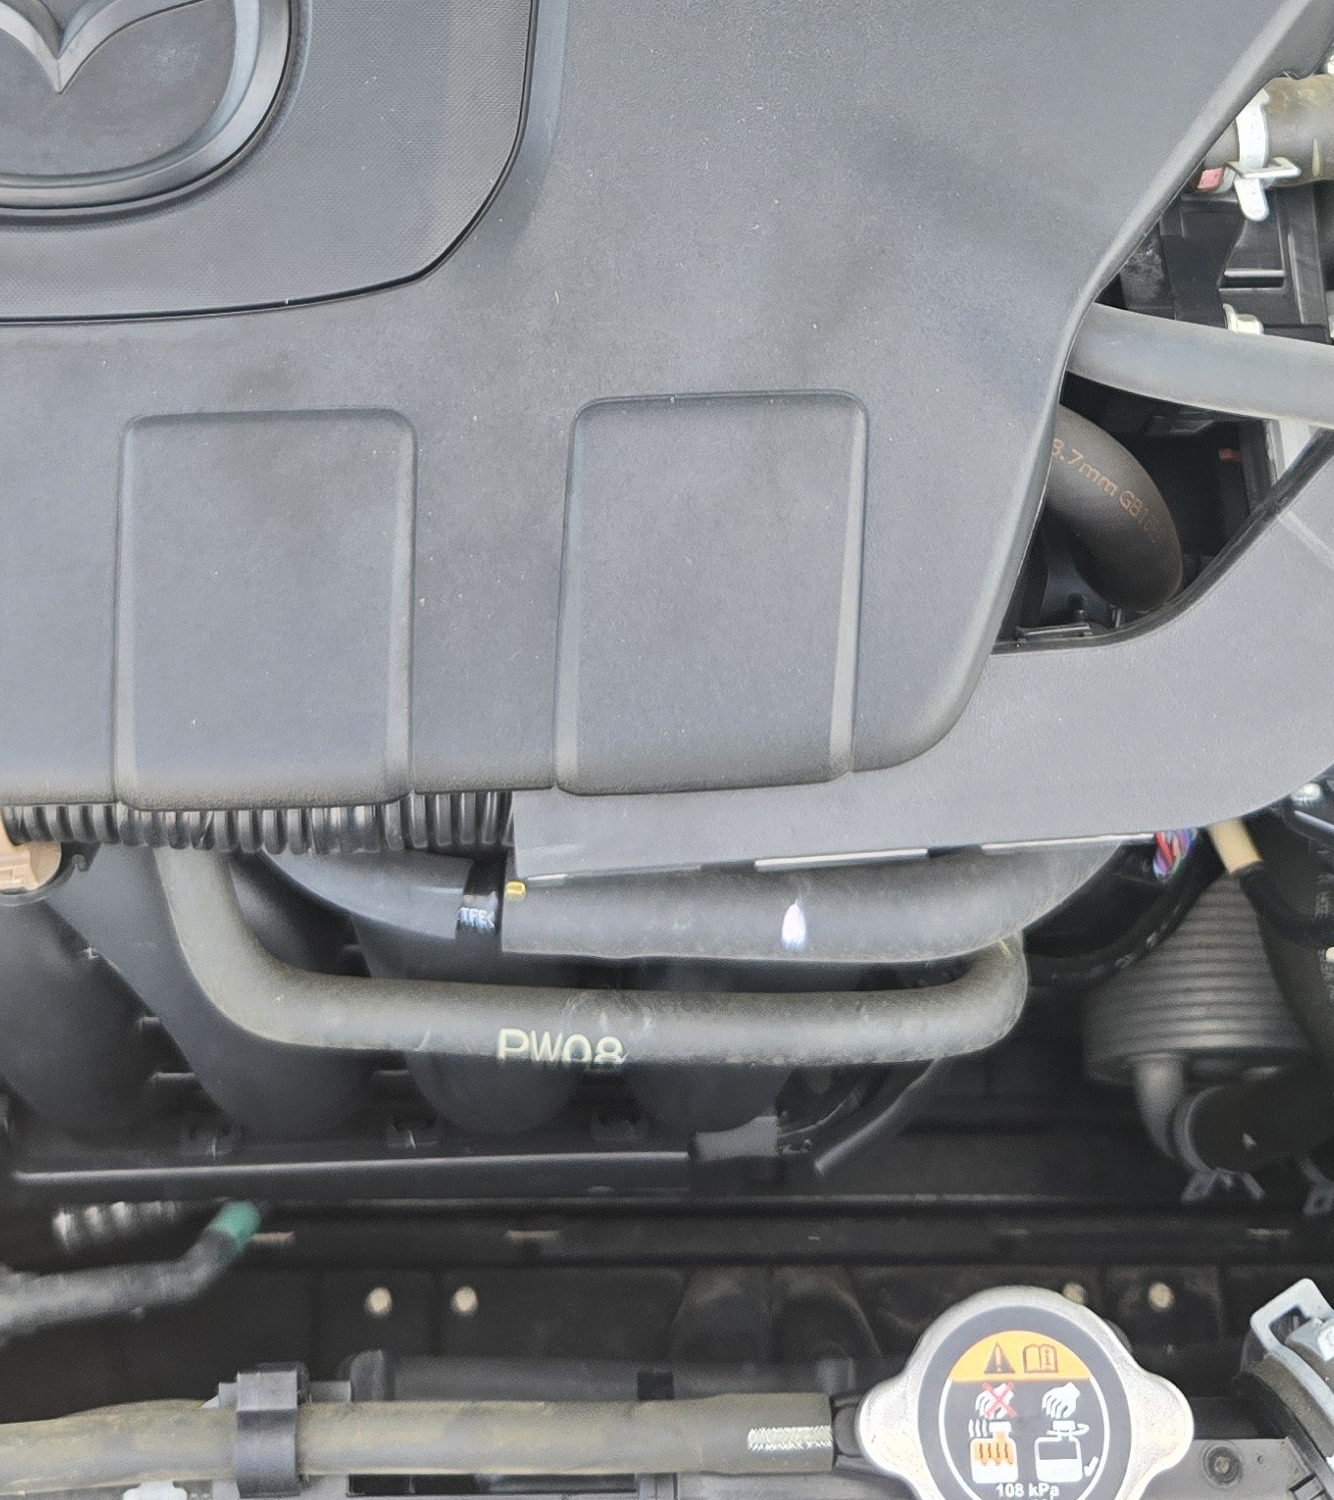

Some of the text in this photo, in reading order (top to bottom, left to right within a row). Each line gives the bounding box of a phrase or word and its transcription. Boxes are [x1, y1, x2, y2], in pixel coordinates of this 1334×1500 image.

[497, 1028, 624, 1065] PW08
[996, 1482, 1060, 1499] 108 kPa
